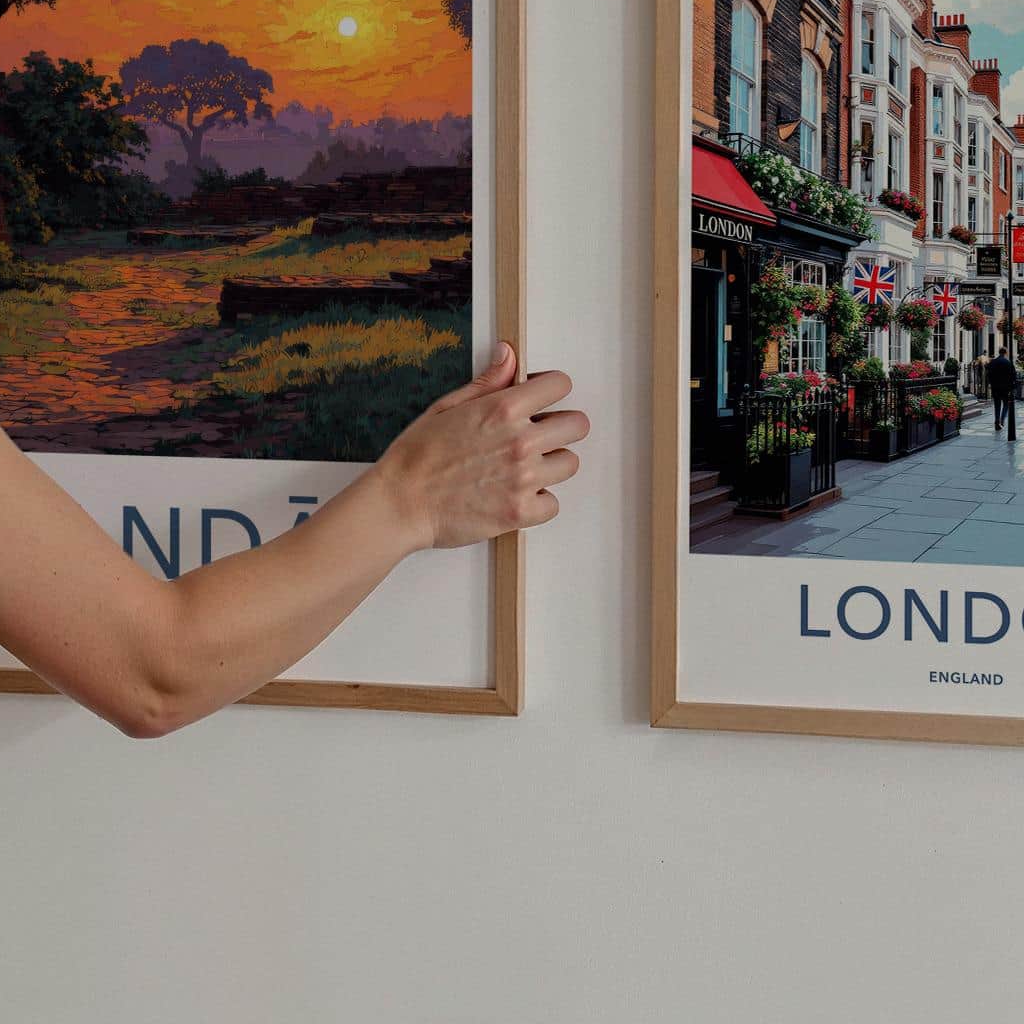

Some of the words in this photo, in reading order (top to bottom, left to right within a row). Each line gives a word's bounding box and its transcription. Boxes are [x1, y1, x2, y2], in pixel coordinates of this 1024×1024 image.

[699, 213, 753, 242] LONDON
[800, 584, 1024, 644] LOND
[929, 671, 1004, 686] ENGLAND
